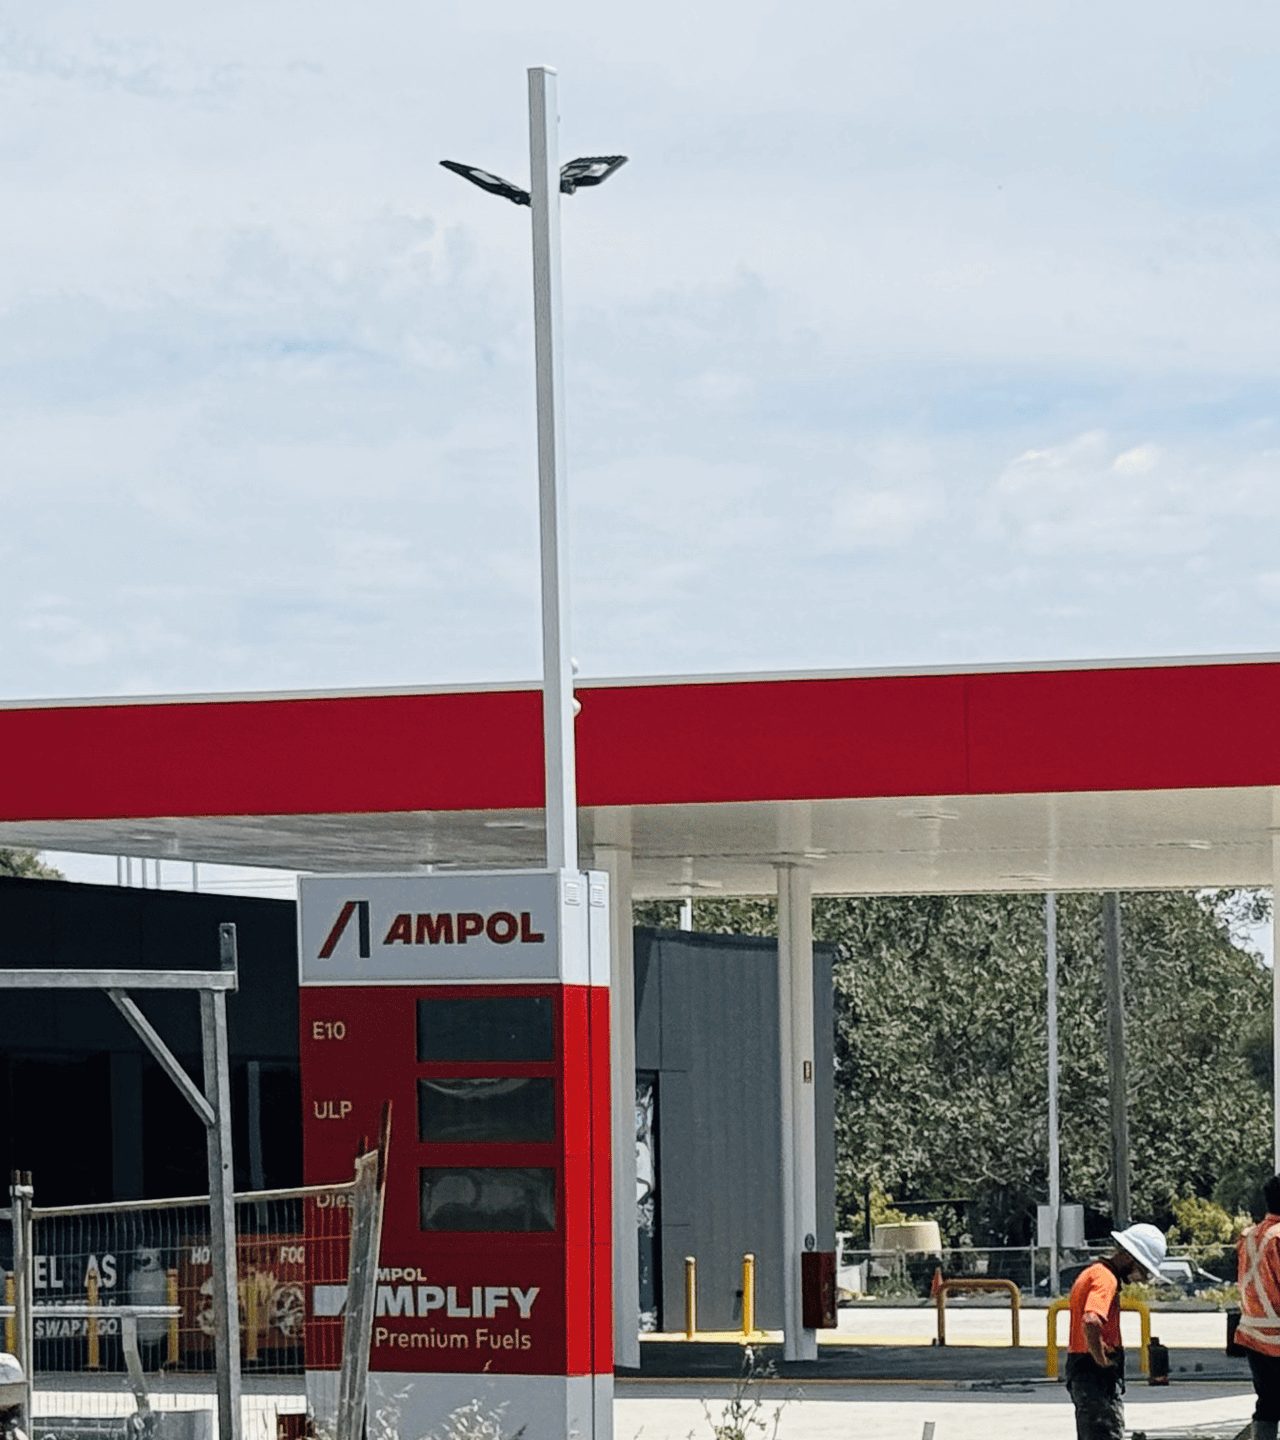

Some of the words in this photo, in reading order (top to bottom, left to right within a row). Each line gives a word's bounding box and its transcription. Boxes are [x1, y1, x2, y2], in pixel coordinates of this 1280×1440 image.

[383, 911, 545, 945] AMPOL
[312, 1021, 346, 1041] E10
[314, 1100, 352, 1120] ULP
[316, 1194, 355, 1209] Dies
[377, 1267, 428, 1282] MPOL
[375, 1285, 541, 1319] MPLIFY
[375, 1327, 469, 1348] Premium
[476, 1328, 532, 1350] Fuels
